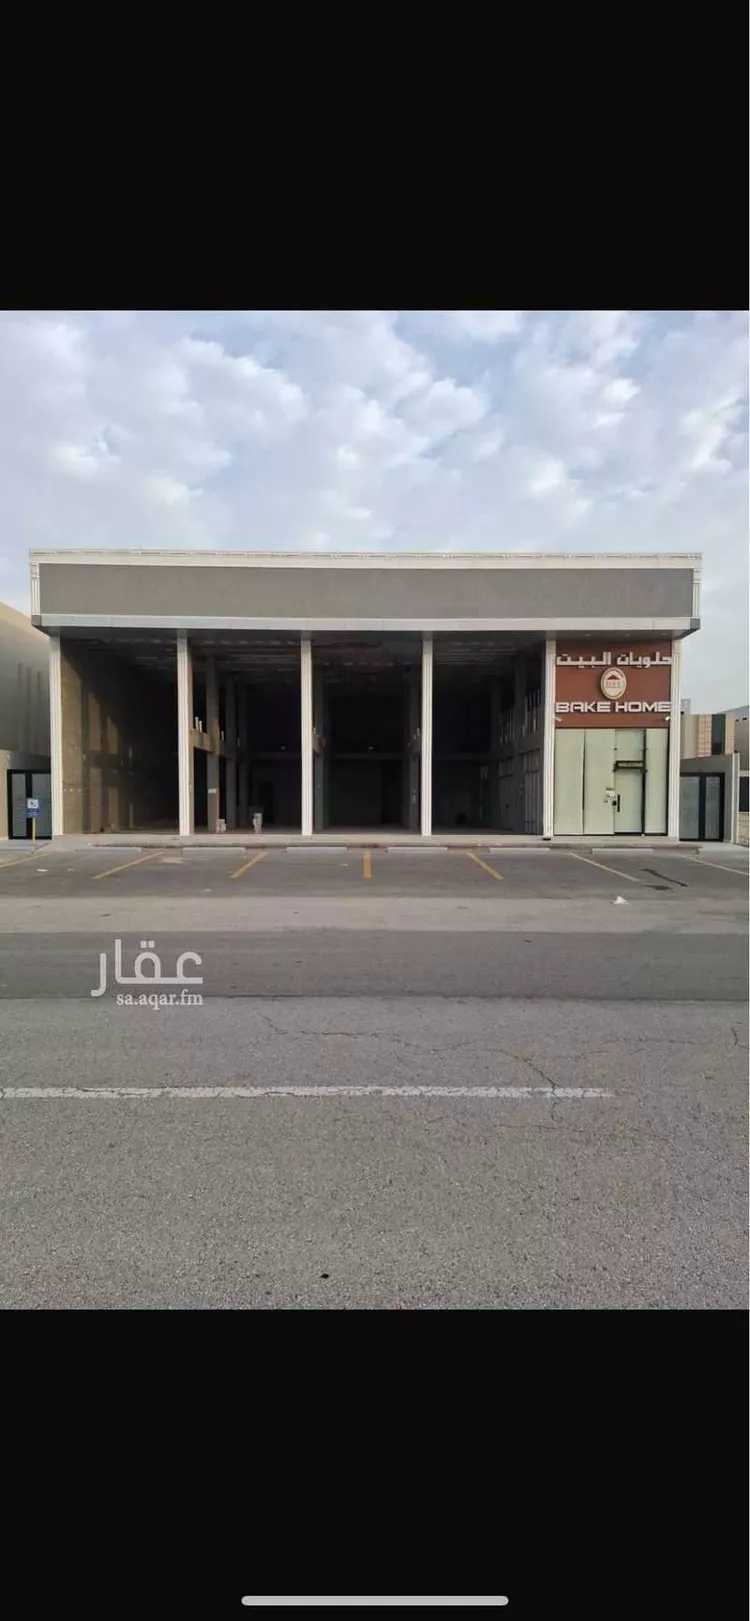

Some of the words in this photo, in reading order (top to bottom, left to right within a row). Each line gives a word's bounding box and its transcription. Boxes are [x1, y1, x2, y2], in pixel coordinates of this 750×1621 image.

[556, 652, 611, 667] البيت
[616, 652, 673, 667] حلويات
[555, 701, 611, 713] BAKE
[615, 701, 672, 713] HOME
